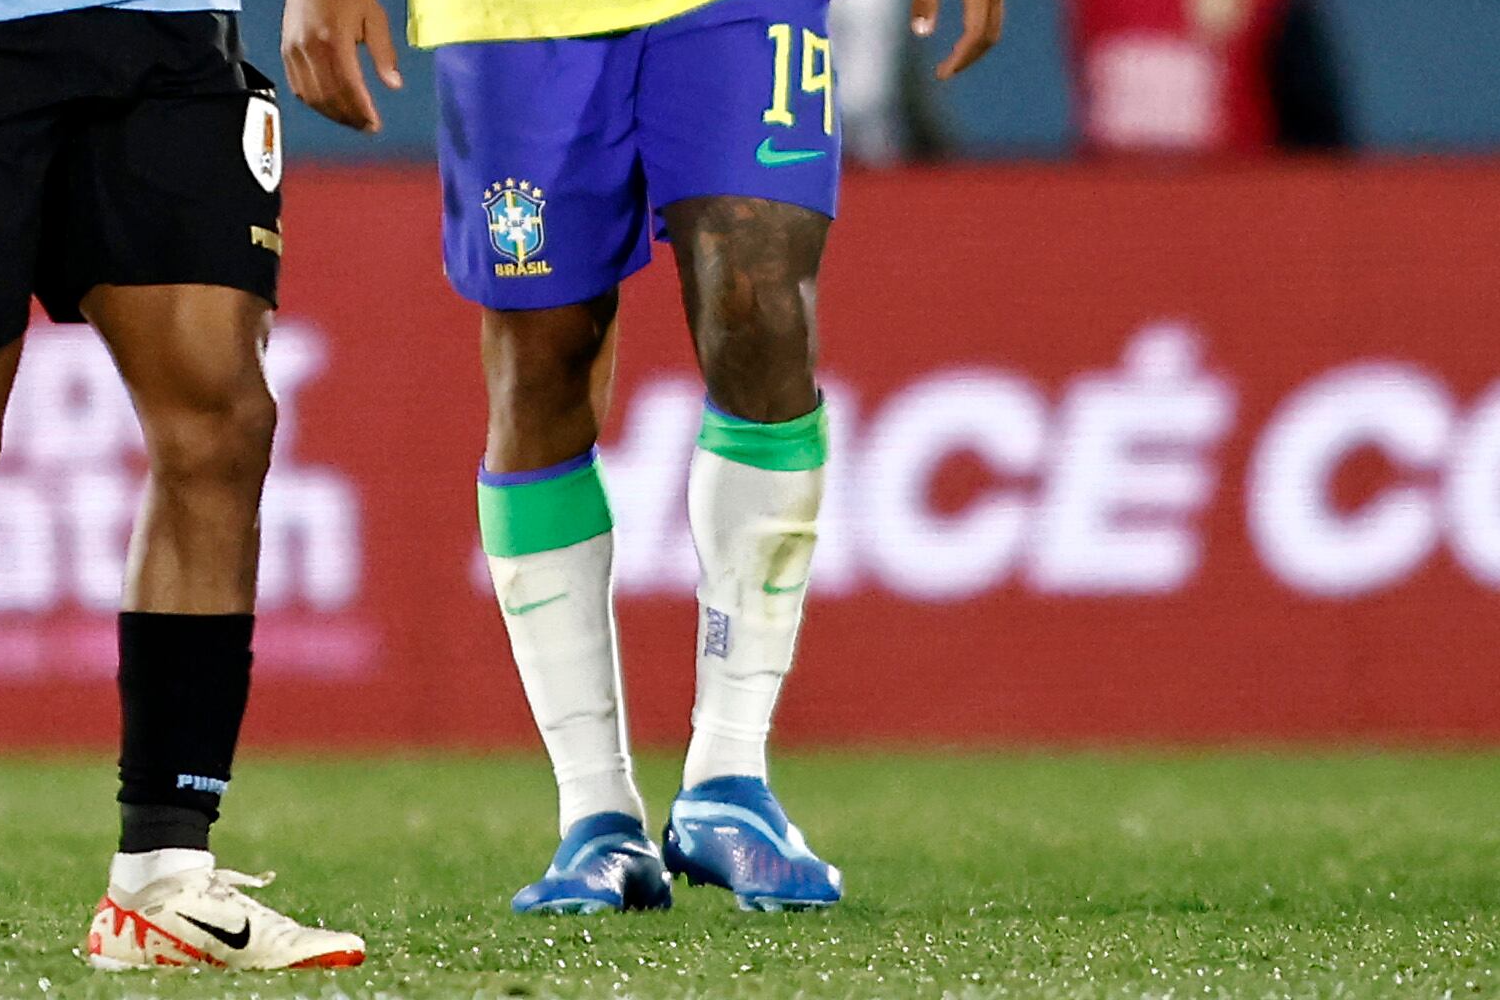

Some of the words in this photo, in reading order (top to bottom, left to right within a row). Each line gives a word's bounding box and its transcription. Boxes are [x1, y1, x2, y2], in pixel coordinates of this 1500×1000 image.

[762, 22, 833, 136] 19
[495, 260, 553, 277] BRASIL
[1245, 362, 1500, 598] C
